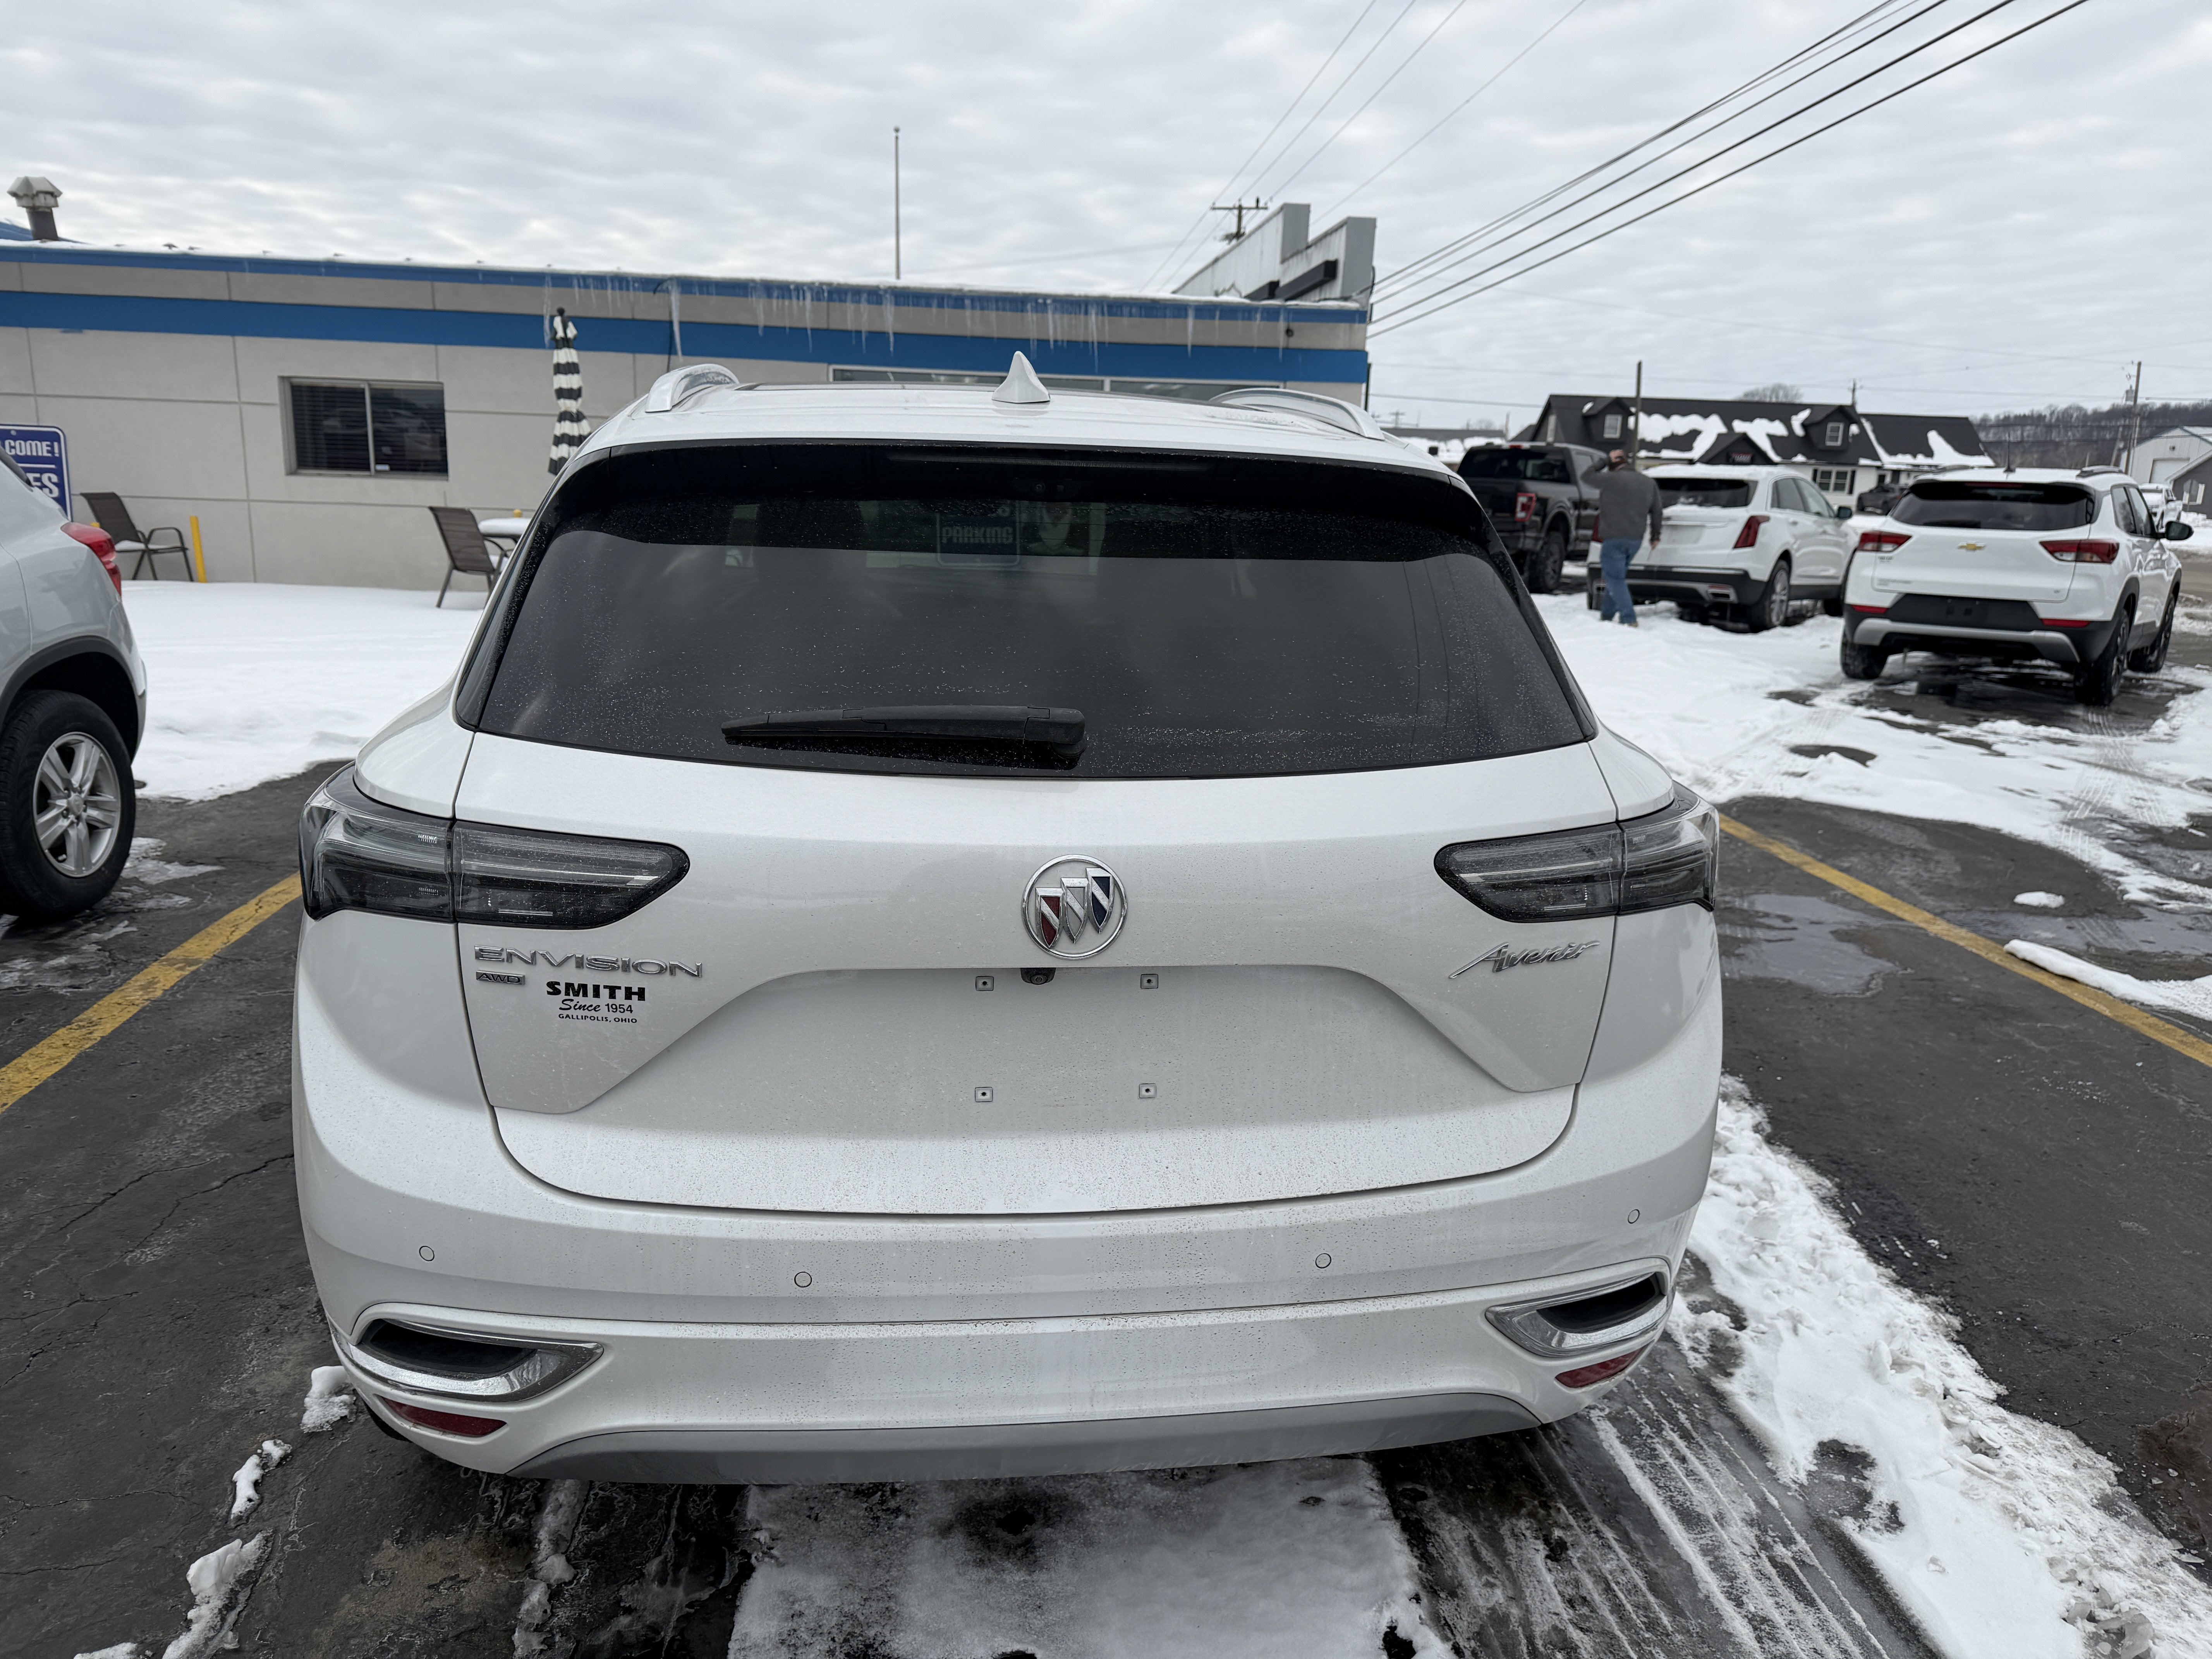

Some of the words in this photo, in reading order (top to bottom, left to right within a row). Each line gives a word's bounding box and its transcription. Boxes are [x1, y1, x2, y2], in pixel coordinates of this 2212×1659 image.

[0, 439, 59, 457] COME!
[474, 945, 703, 978] ENVISION
[1448, 941, 1600, 979] Avenir
[477, 972, 521, 984] AWD
[546, 981, 646, 1001] SMITH
[559, 998, 601, 1012] Since
[605, 1003, 633, 1014] 1954
[558, 1013, 611, 1023] GALLIPOLIS,
